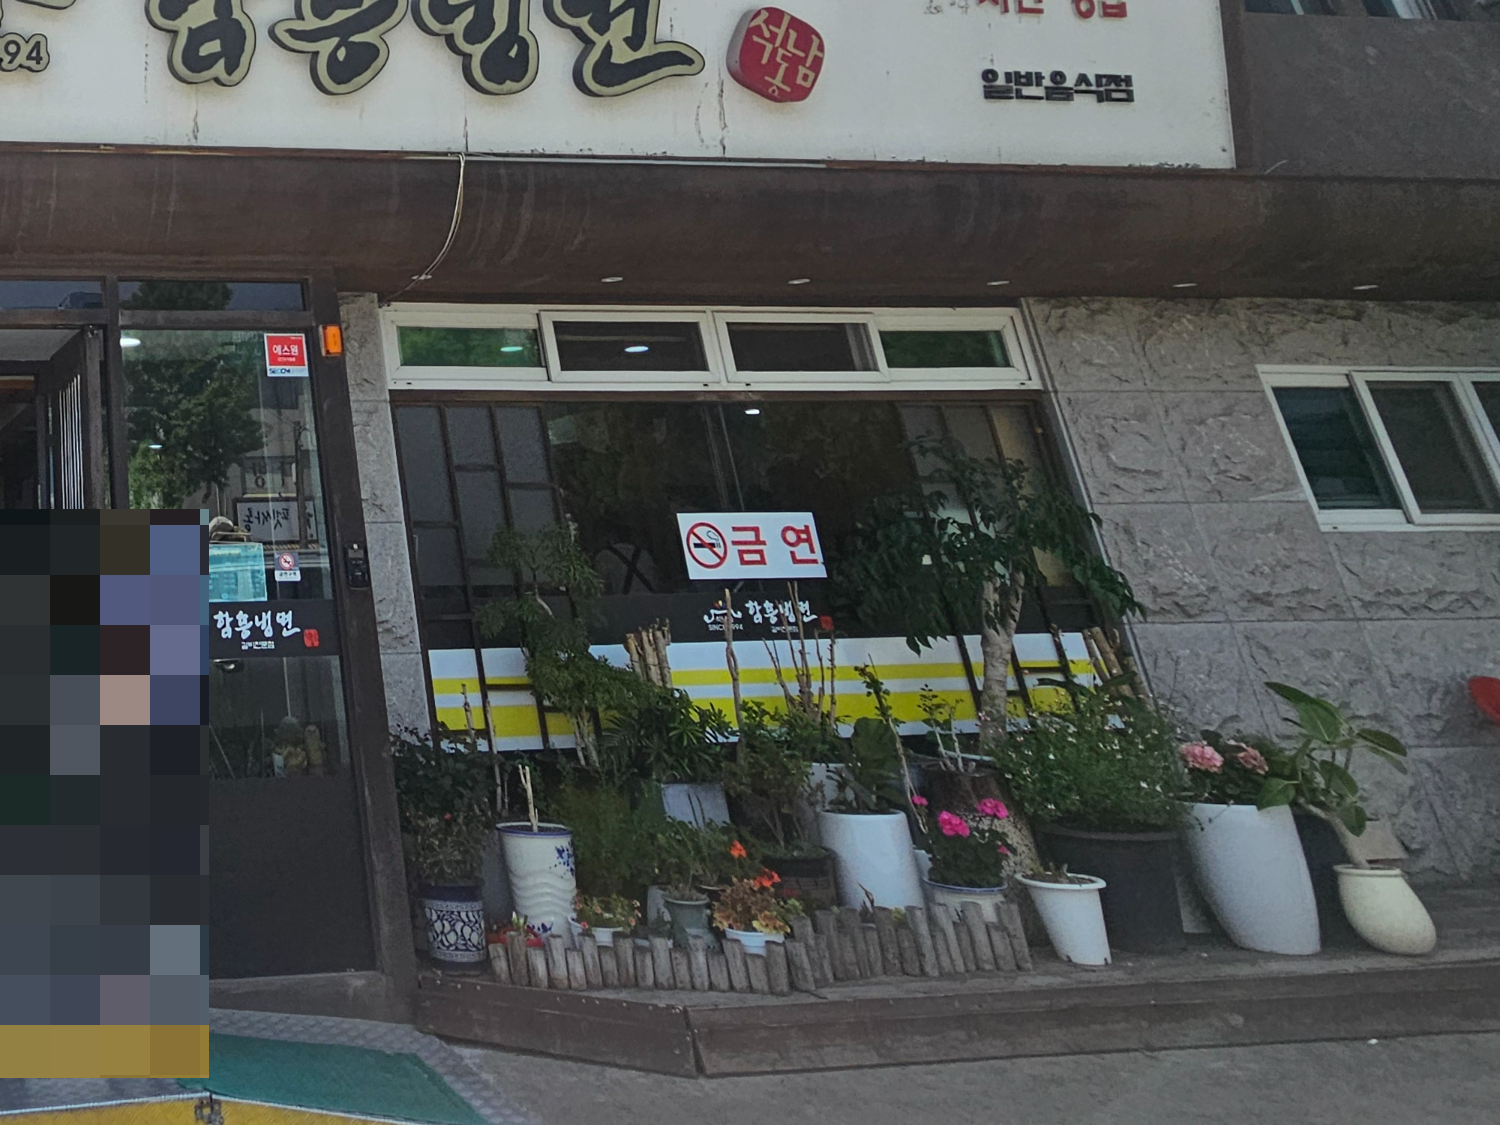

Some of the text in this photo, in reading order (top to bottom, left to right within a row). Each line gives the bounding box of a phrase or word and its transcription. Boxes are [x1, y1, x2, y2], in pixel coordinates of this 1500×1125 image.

[980, 68, 1135, 103] 일반음식점
[272, 344, 299, 356] 에스원
[731, 524, 819, 566] 금연
[213, 610, 301, 640] 함흥냉면
